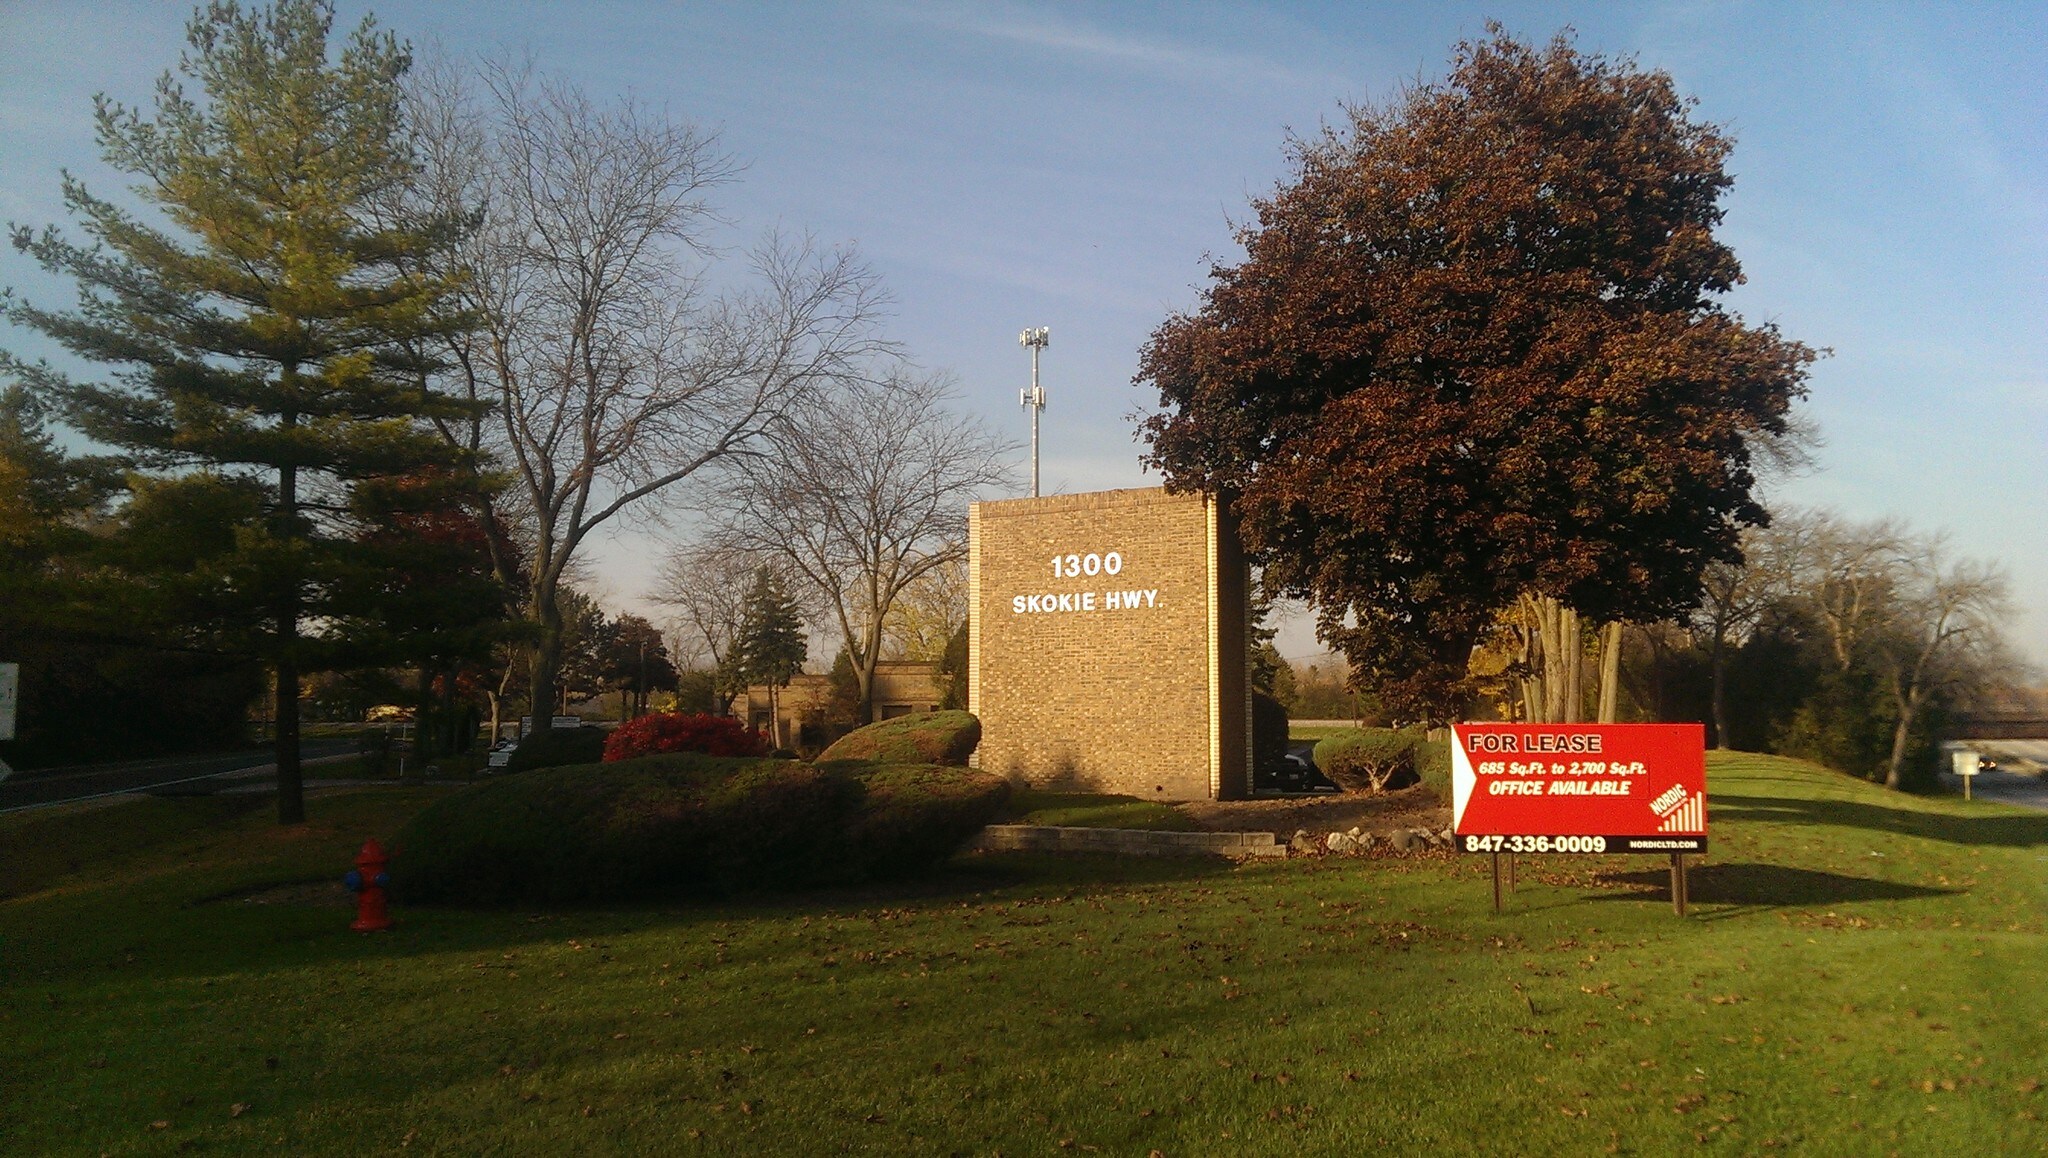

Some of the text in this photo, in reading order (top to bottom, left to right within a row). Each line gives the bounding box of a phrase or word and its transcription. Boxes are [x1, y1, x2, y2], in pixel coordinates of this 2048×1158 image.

[1051, 552, 1122, 578] 1300
[1012, 589, 1163, 614] SKOKIE HWY.
[1468, 734, 1602, 753] FOR LEASE
[1478, 762, 1505, 774] 685
[1551, 763, 1565, 774] to
[1568, 762, 1606, 775] 2,700
[1489, 781, 1632, 795] OFFICE AVAILABLE
[1649, 783, 1687, 815] NORDIC
[1466, 835, 1606, 852] 847-336-0009
[1629, 840, 1698, 848] NORDICLTD.COM
